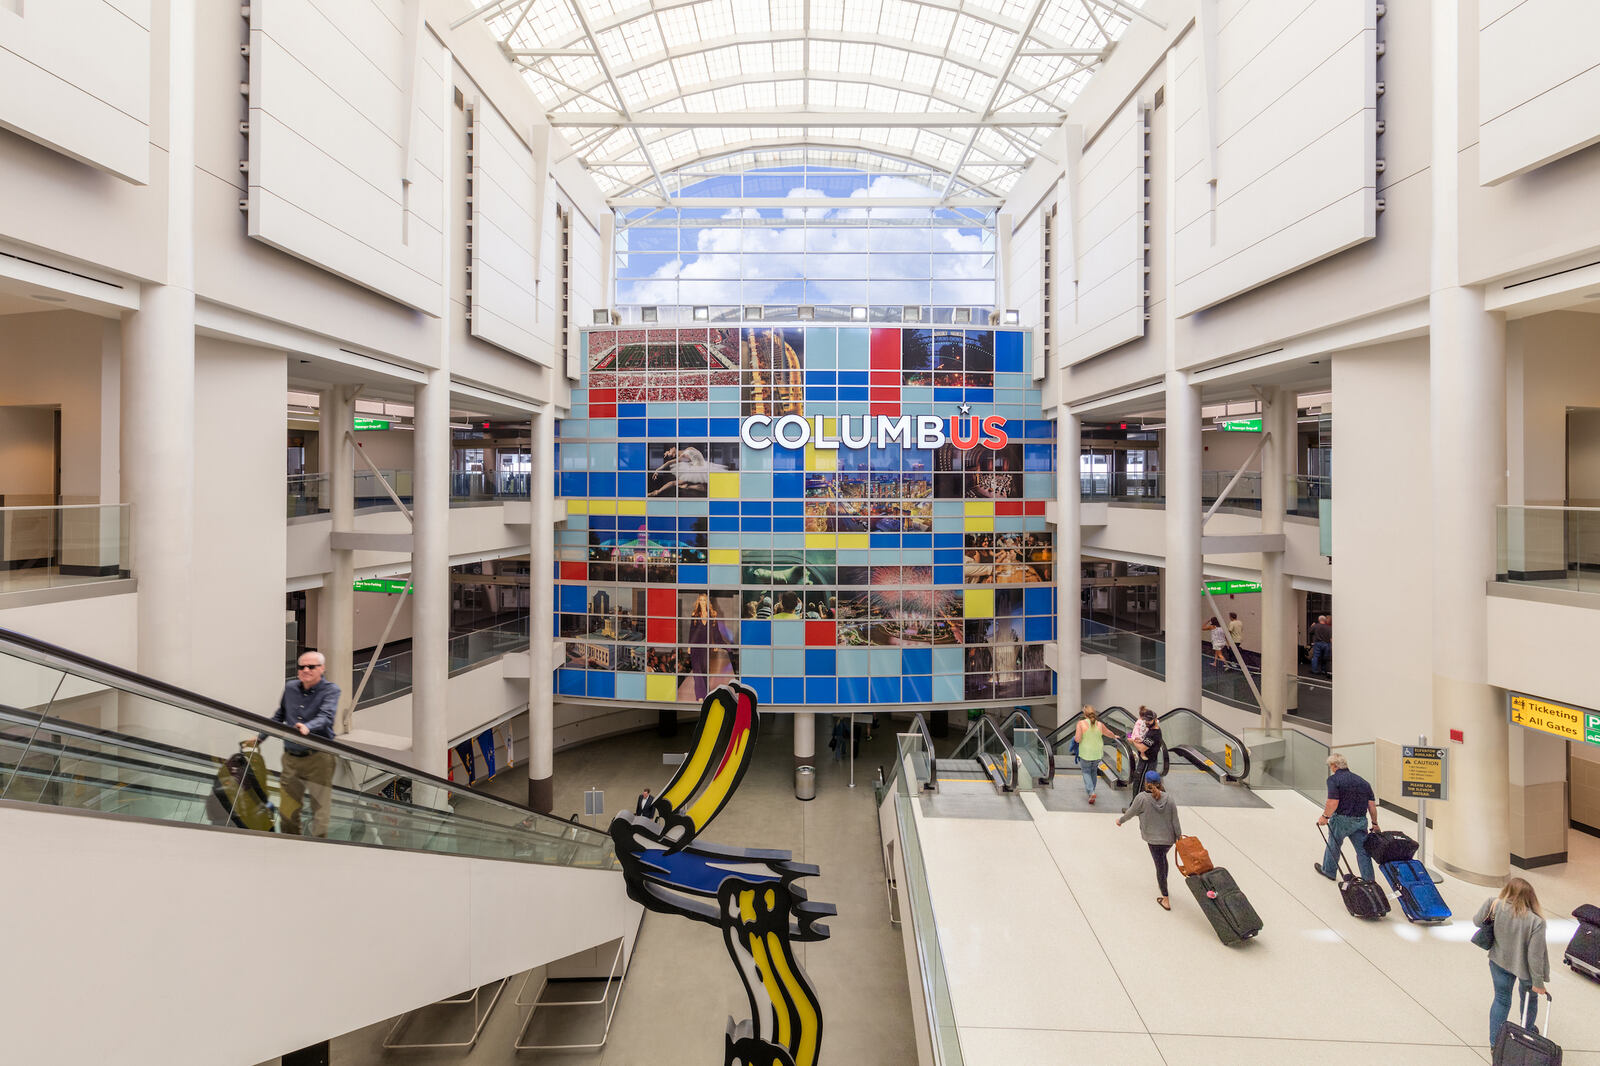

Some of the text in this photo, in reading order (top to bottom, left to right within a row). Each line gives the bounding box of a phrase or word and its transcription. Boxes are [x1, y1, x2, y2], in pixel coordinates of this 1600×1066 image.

[741, 414, 1008, 450] COLUMBUS
[1529, 703, 1578, 723] Ticketing
[1529, 717, 1578, 735] All Gates
